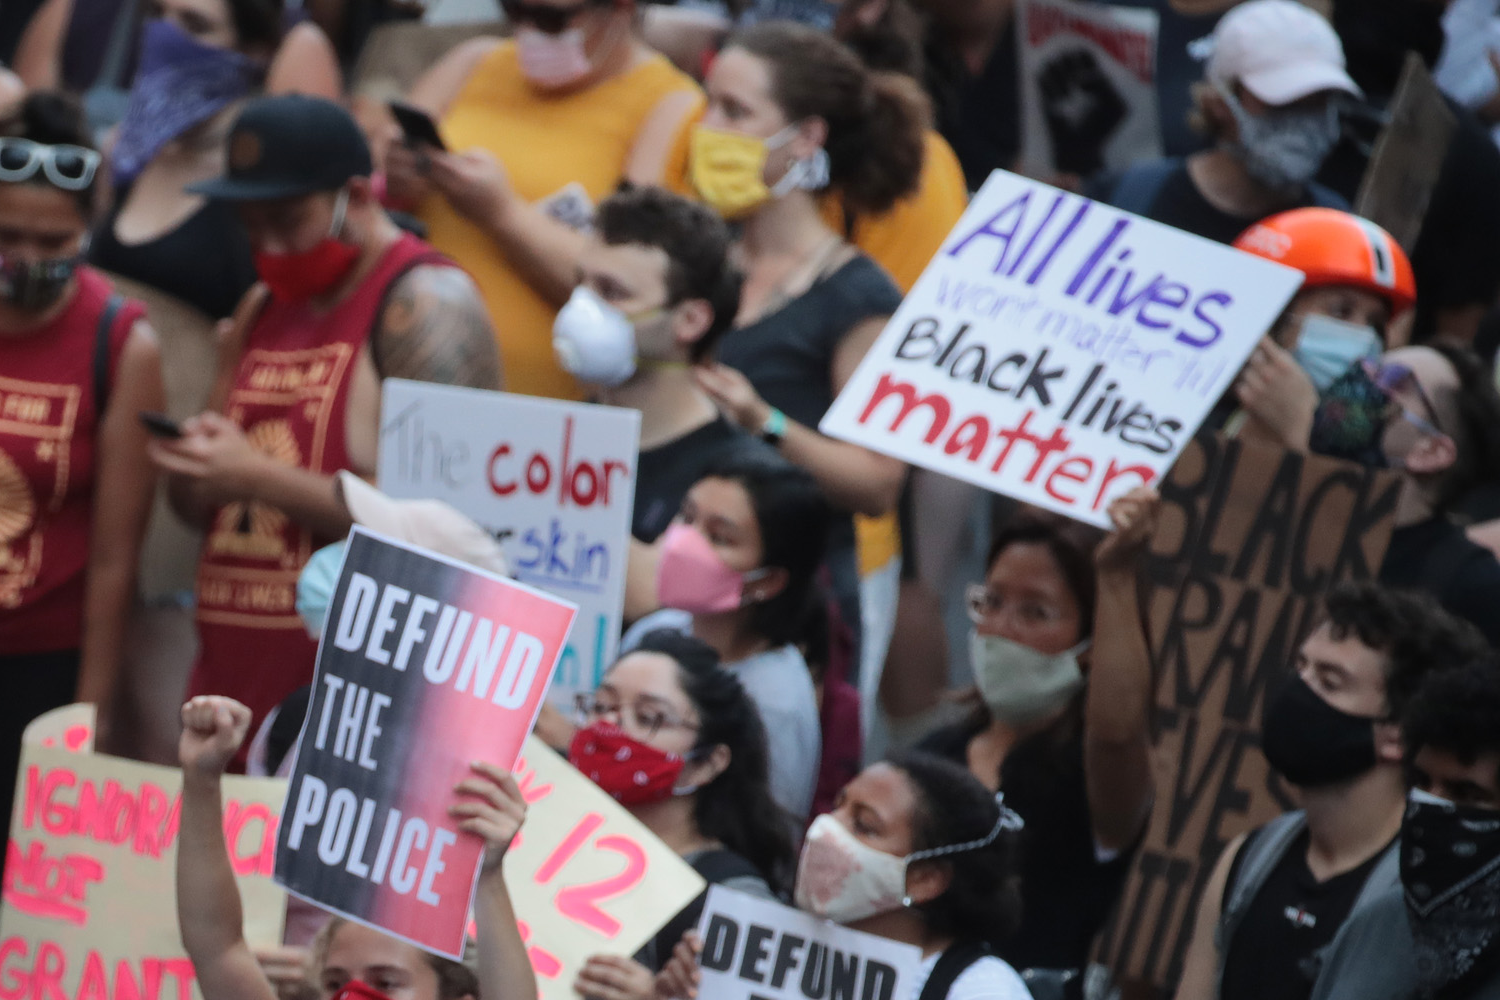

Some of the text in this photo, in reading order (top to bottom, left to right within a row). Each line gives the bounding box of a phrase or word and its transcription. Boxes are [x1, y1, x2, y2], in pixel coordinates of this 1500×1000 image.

[945, 188, 1234, 349] All lives
[856, 373, 1158, 512] matter
[894, 317, 1184, 456] Black lives
[379, 401, 629, 508] The color
[1140, 428, 1400, 592] BLACK
[515, 517, 611, 582] skin
[333, 571, 544, 711] DEFUND
[314, 673, 392, 772] THE
[3, 838, 106, 902] NOT
[22, 764, 279, 876] IGNORC
[287, 774, 456, 907] POLICE
[533, 811, 649, 940] 12
